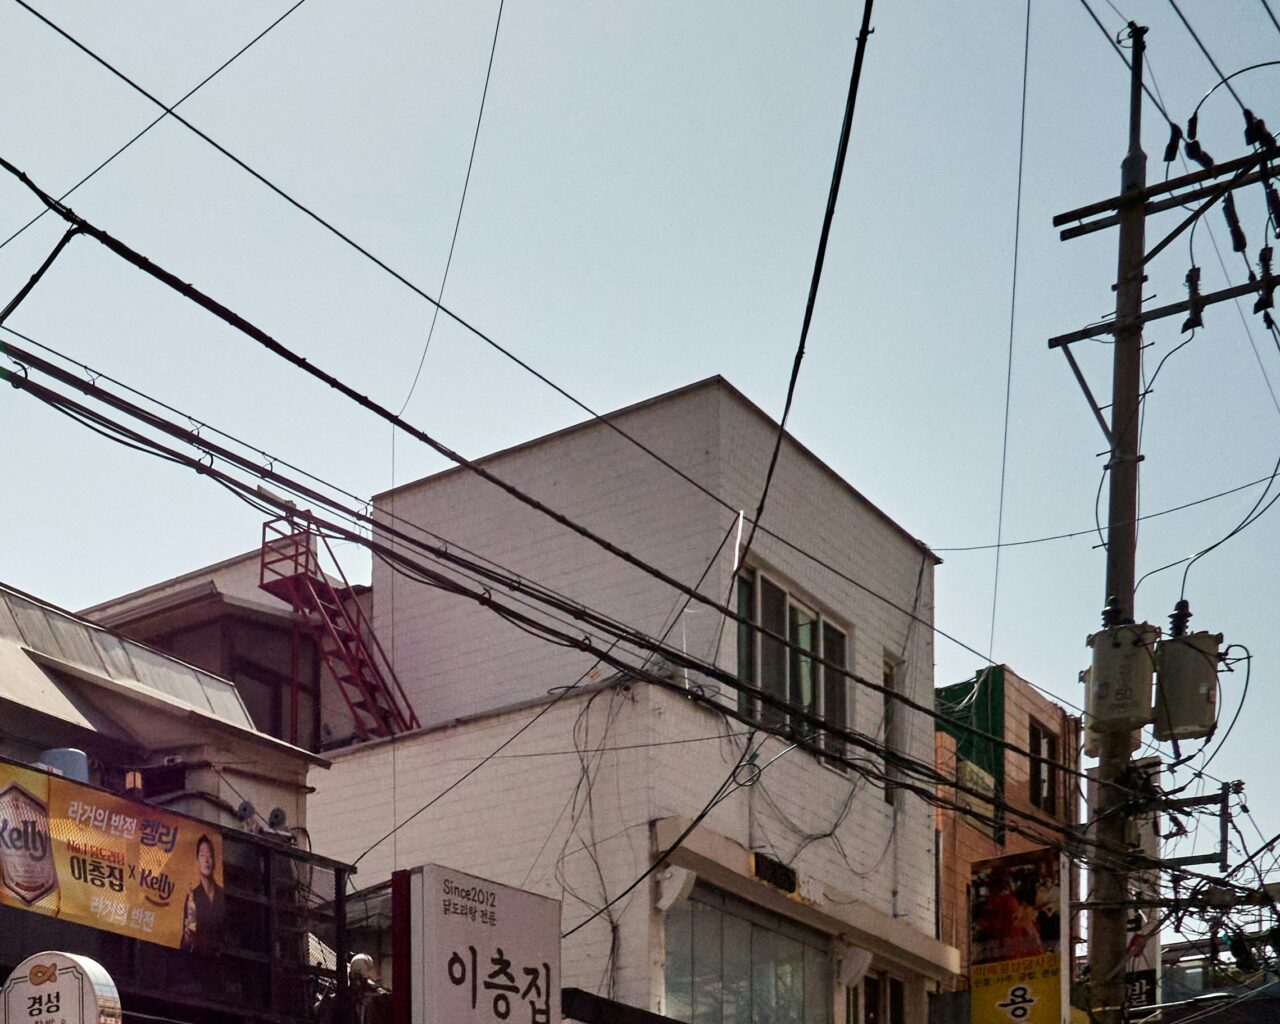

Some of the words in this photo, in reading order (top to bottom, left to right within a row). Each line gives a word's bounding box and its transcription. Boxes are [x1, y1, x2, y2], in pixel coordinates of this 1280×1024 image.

[68, 801, 104, 834] 라거의
[105, 810, 137, 839] 반전
[139, 817, 180, 852] 켈리
[70, 853, 125, 891] 이층집
[140, 868, 176, 899] Kelly
[443, 880, 497, 908] Since2012
[90, 895, 128, 927] 라거의
[131, 904, 157, 931] 반전
[443, 899, 477, 922] 닭도리탕
[27, 992, 60, 1017] 경성
